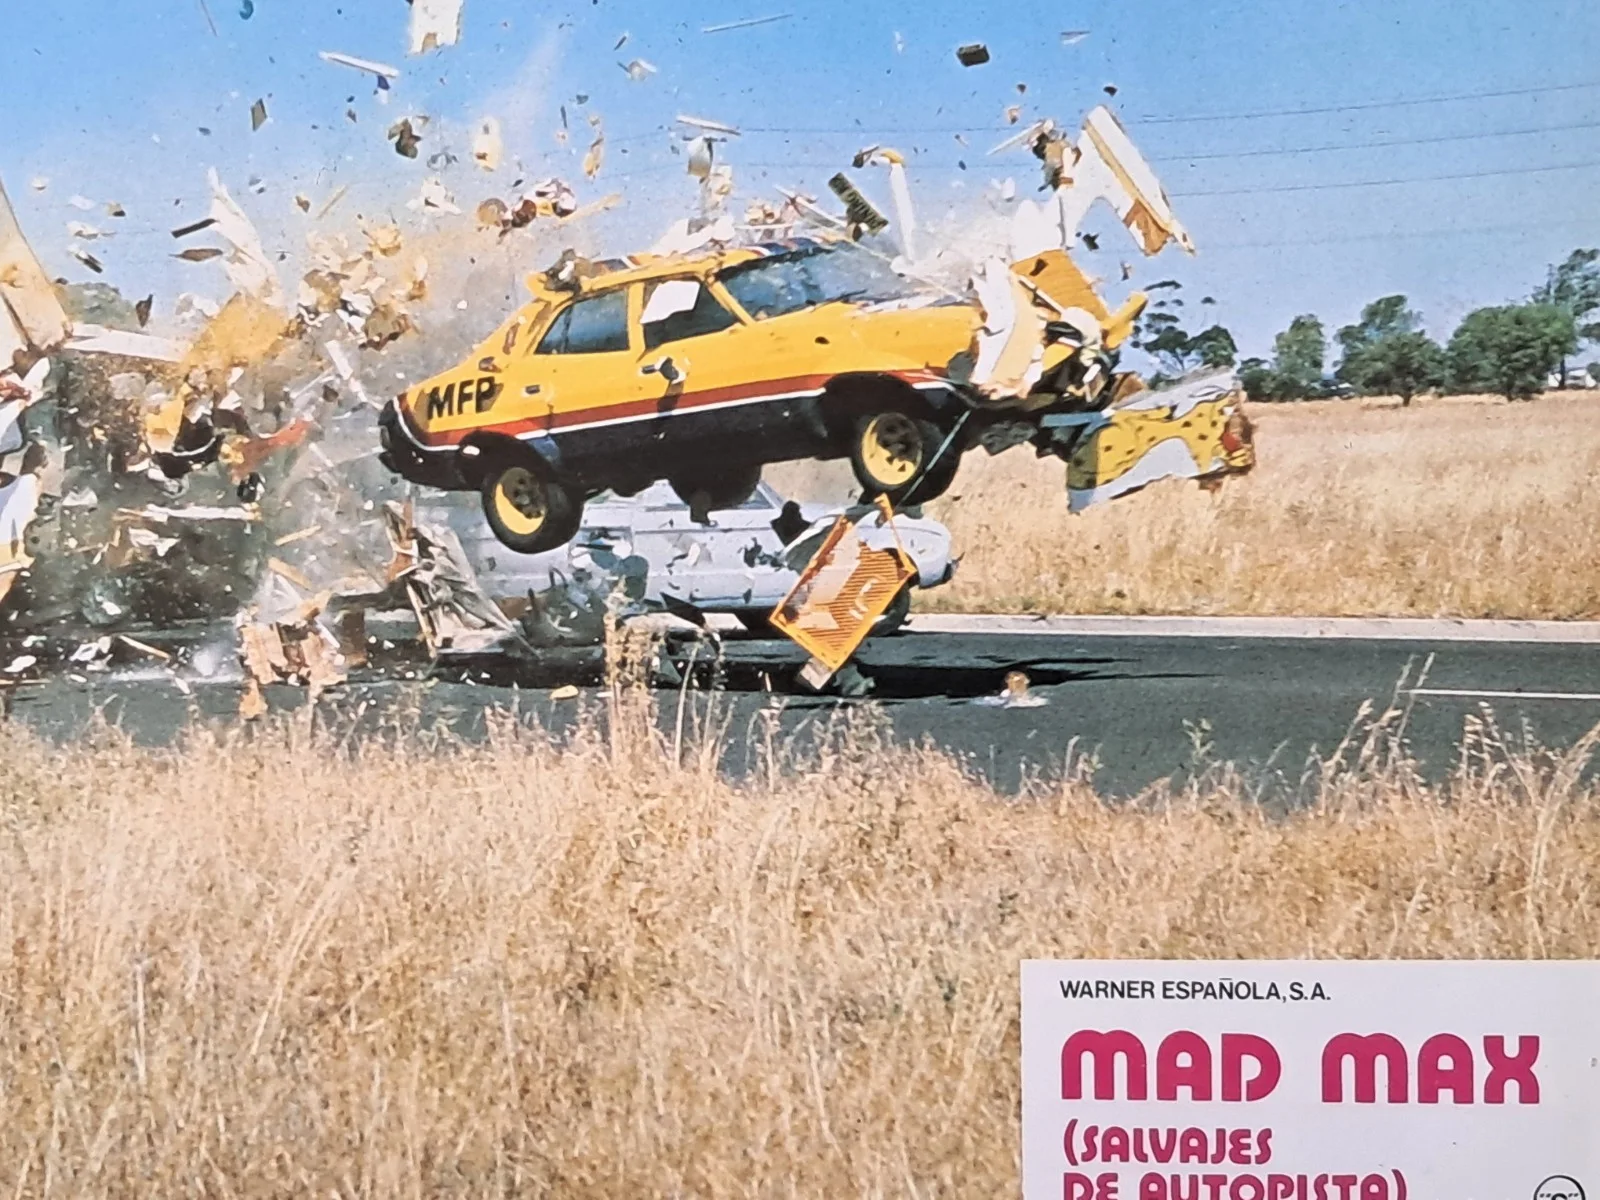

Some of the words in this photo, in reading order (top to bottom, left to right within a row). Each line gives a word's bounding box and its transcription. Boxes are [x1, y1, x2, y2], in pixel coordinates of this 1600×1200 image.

[427, 376, 496, 420] MFP
[1060, 980, 1155, 999] WARNER
[1061, 1029, 1282, 1102] MAD
[1321, 1033, 1540, 1105] MAX
[1063, 1118, 1273, 1167] (SALVAJES
[1063, 1172, 1119, 1200] DE
[1139, 1168, 1408, 1200] AUTOPISTA)
